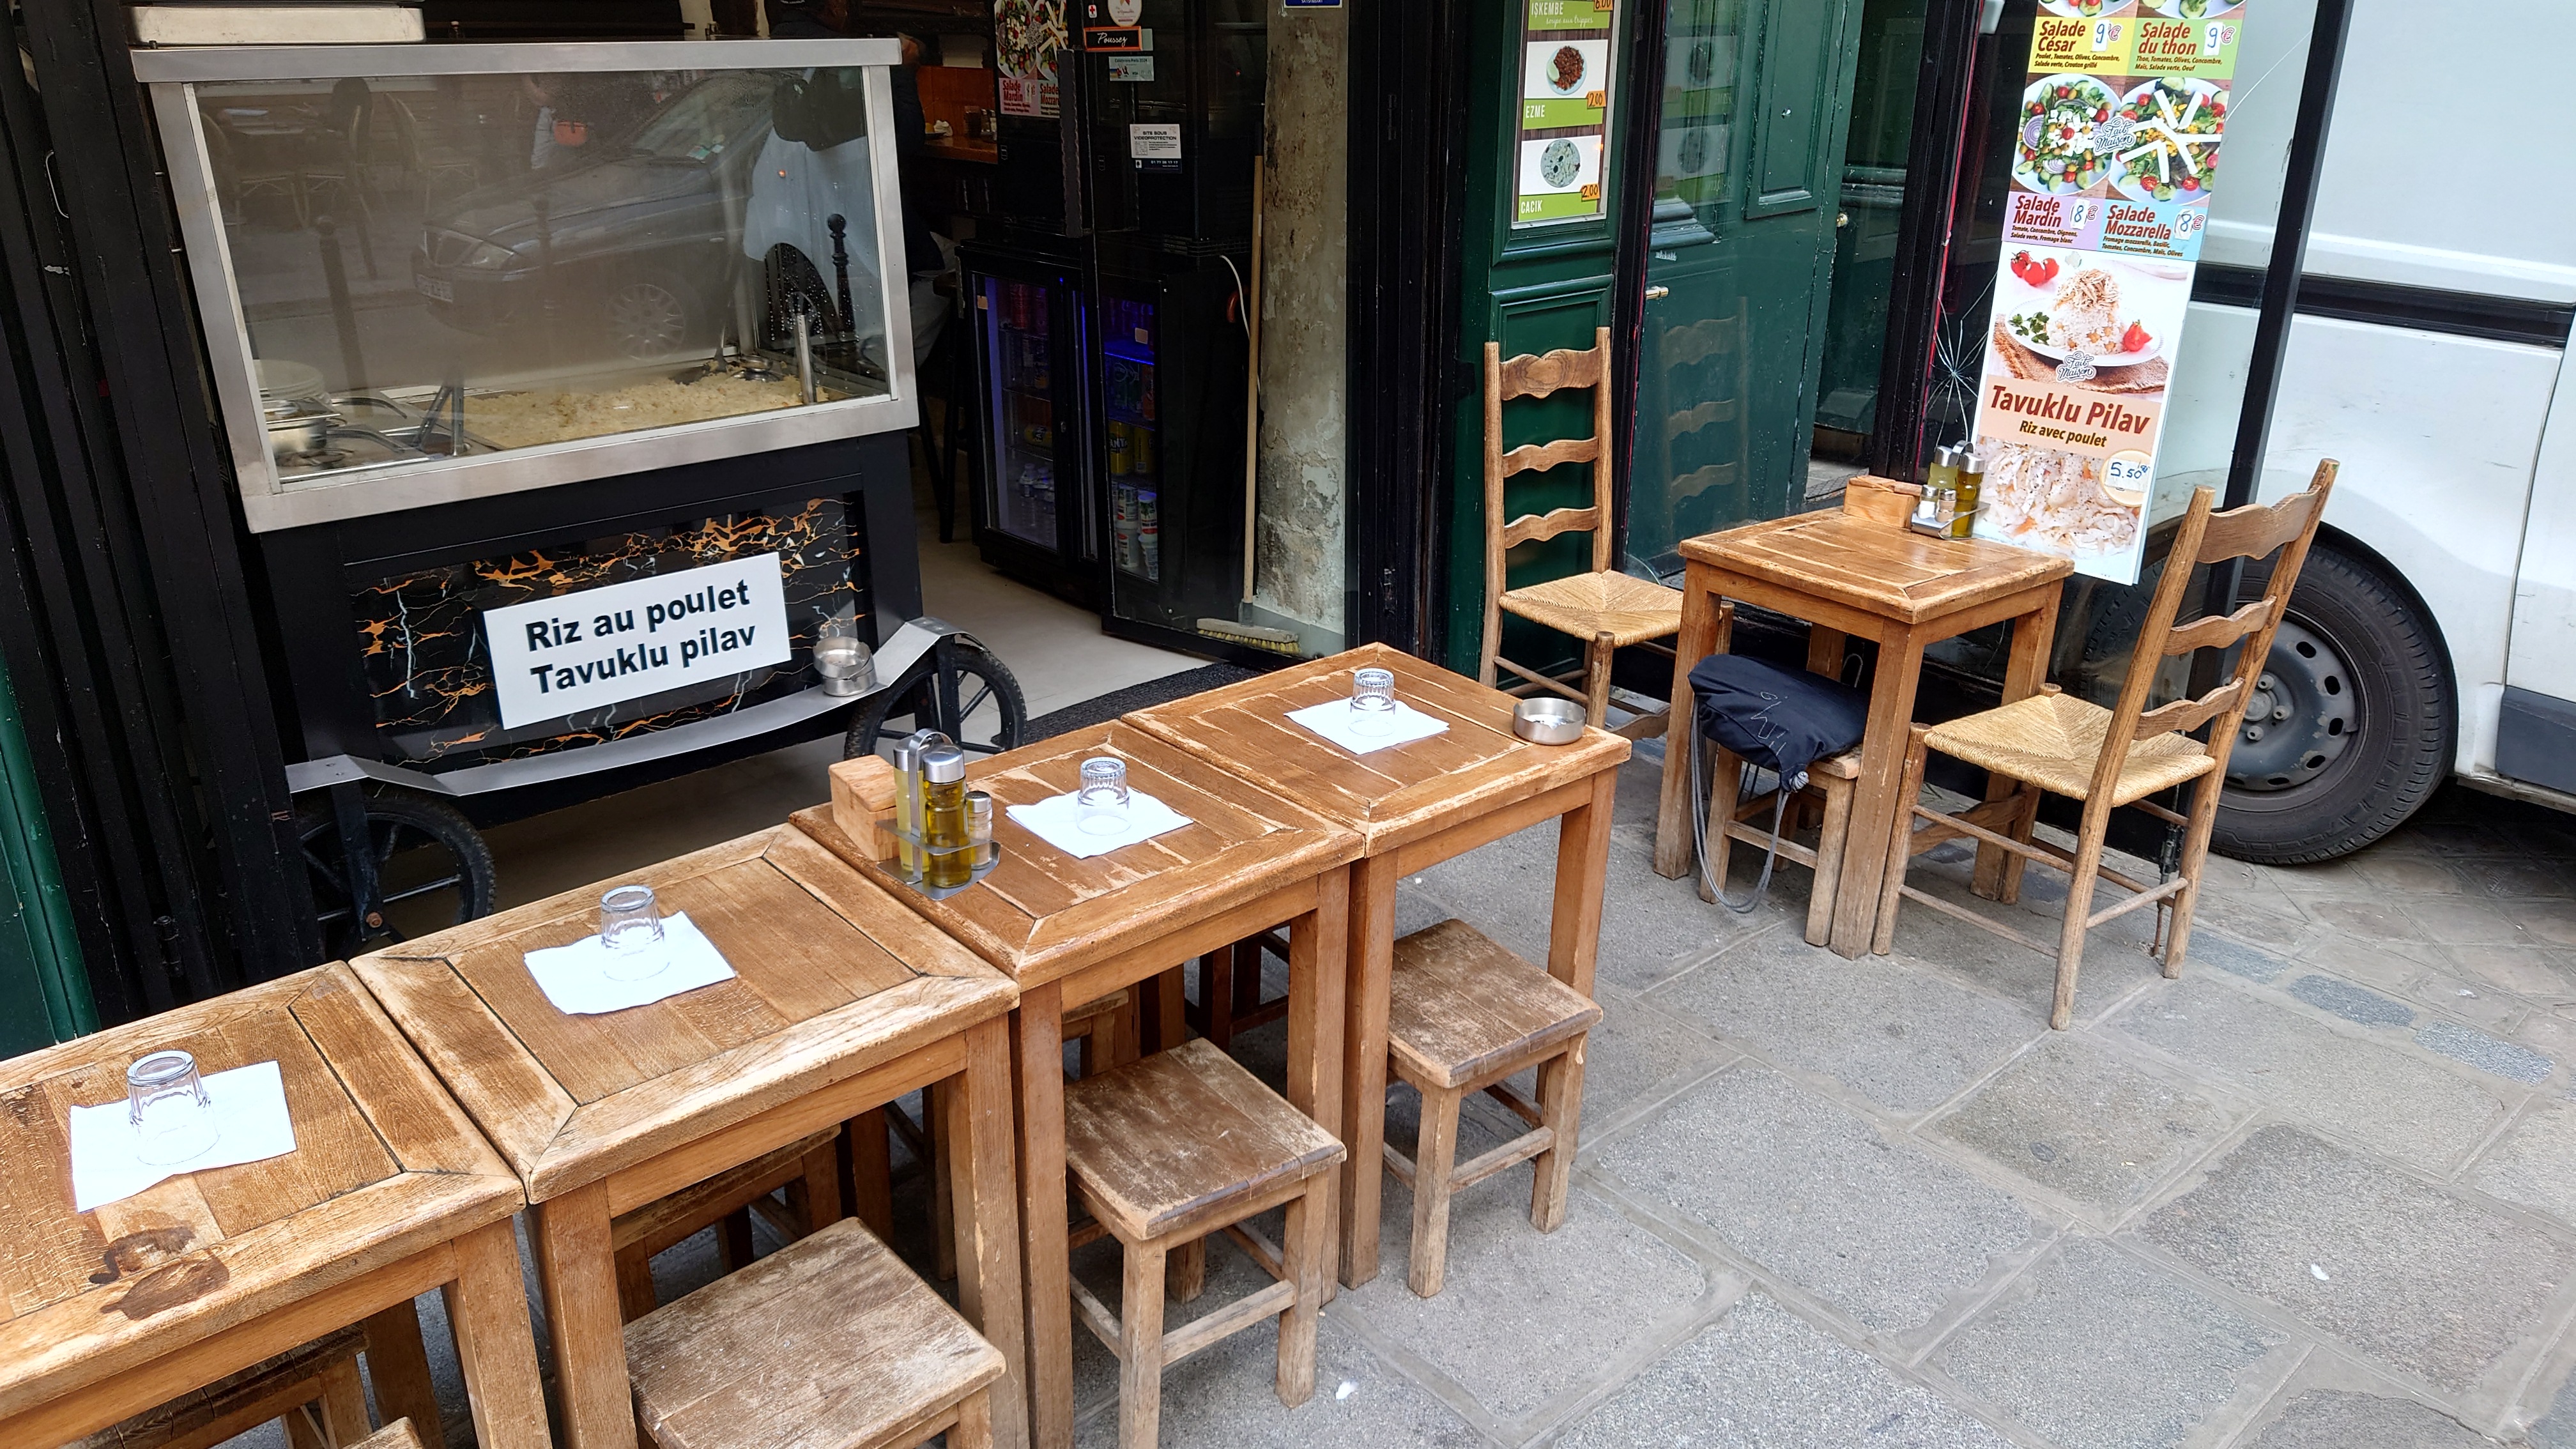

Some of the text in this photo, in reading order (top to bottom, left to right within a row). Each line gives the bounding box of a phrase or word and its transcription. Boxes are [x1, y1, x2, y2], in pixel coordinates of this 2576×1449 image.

[2039, 20, 2085, 37] Salade
[2140, 22, 2191, 38] Salade
[2038, 36, 2076, 52] César
[2138, 38, 2197, 55] du thon
[1003, 80, 1021, 91] Salade
[1040, 84, 1059, 95] Salade
[1004, 91, 1023, 102] Mardin
[1526, 105, 1545, 118] EZME
[2104, 119, 2133, 137] Fait
[2097, 135, 2133, 151] Maison
[1521, 200, 1542, 213] CACIK
[2015, 195, 2060, 212] Salade
[2013, 210, 2062, 227] Mardin
[2107, 204, 2155, 222] Salade
[2104, 220, 2171, 240] Mozzarella
[2066, 353, 2092, 368] Fait
[2059, 367, 2093, 379] Maison
[1991, 385, 2150, 434] Tavuklu Pilav
[2019, 420, 2107, 448] Riz avec poulet
[525, 579, 750, 652] Riz au poulet
[530, 625, 756, 694] Tavuklu pilav
